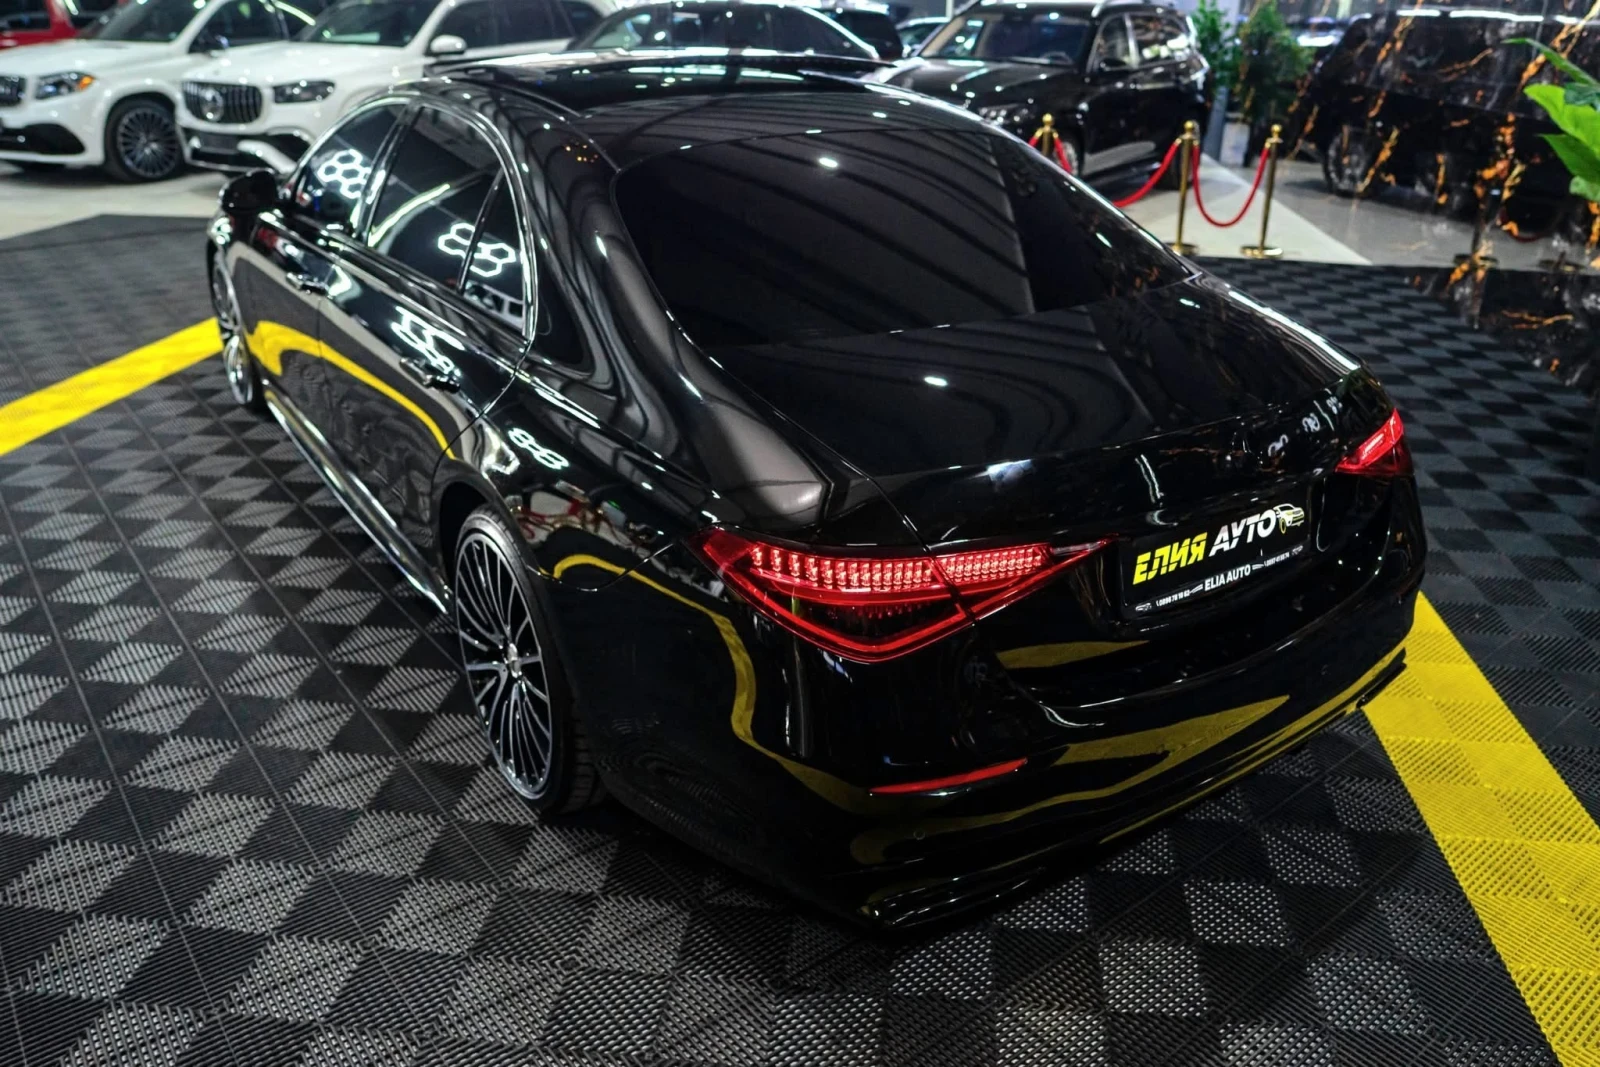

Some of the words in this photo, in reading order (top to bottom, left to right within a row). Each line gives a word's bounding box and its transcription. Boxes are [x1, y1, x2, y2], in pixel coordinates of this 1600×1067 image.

[1132, 531, 1208, 585] ЕЛИЯ
[1209, 509, 1277, 557] АУТО
[1204, 575, 1226, 591] ELIA
[1226, 564, 1251, 584] AUTO
